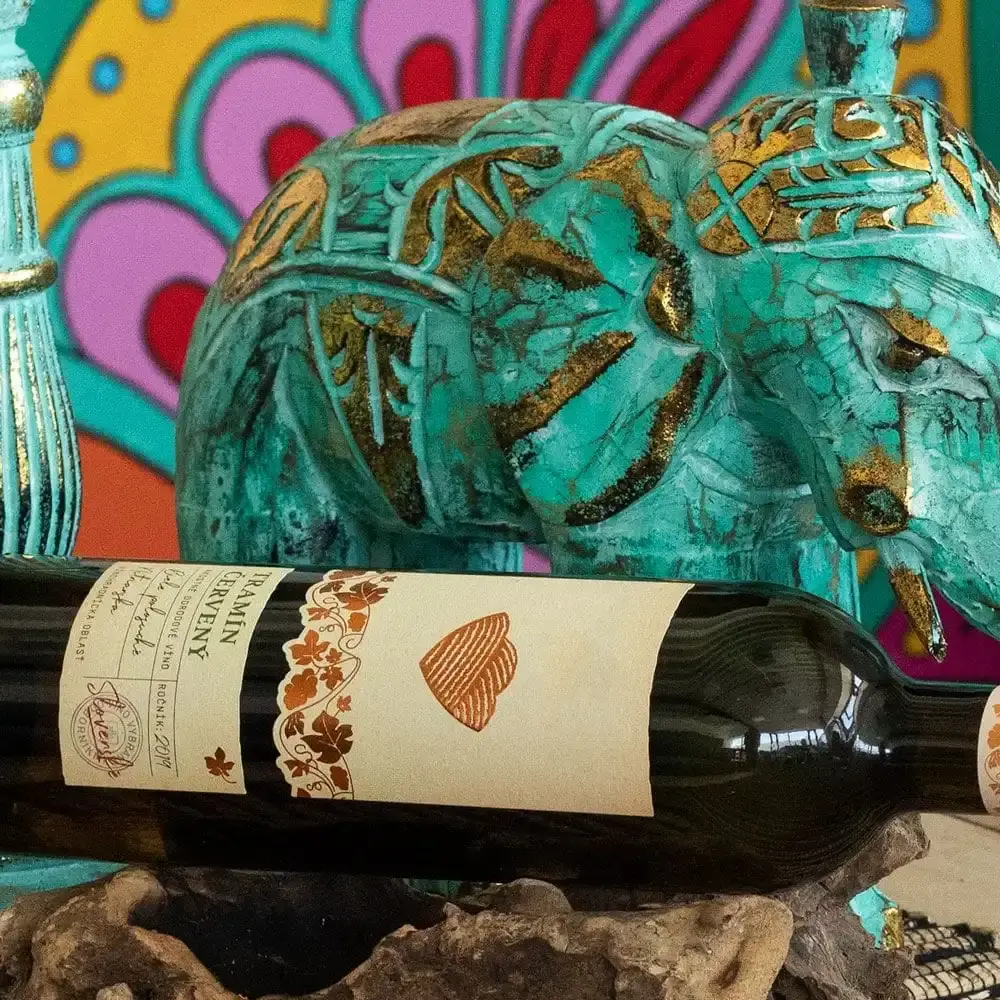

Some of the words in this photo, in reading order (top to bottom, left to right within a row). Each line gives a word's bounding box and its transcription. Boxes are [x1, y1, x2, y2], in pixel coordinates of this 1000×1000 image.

[188, 571, 243, 661] ČERVENÝ
[220, 572, 273, 645] TRAMÍN
[161, 644, 176, 670] VÍNO
[152, 683, 167, 731] ROČNÍK:
[154, 733, 173, 769] 2019
